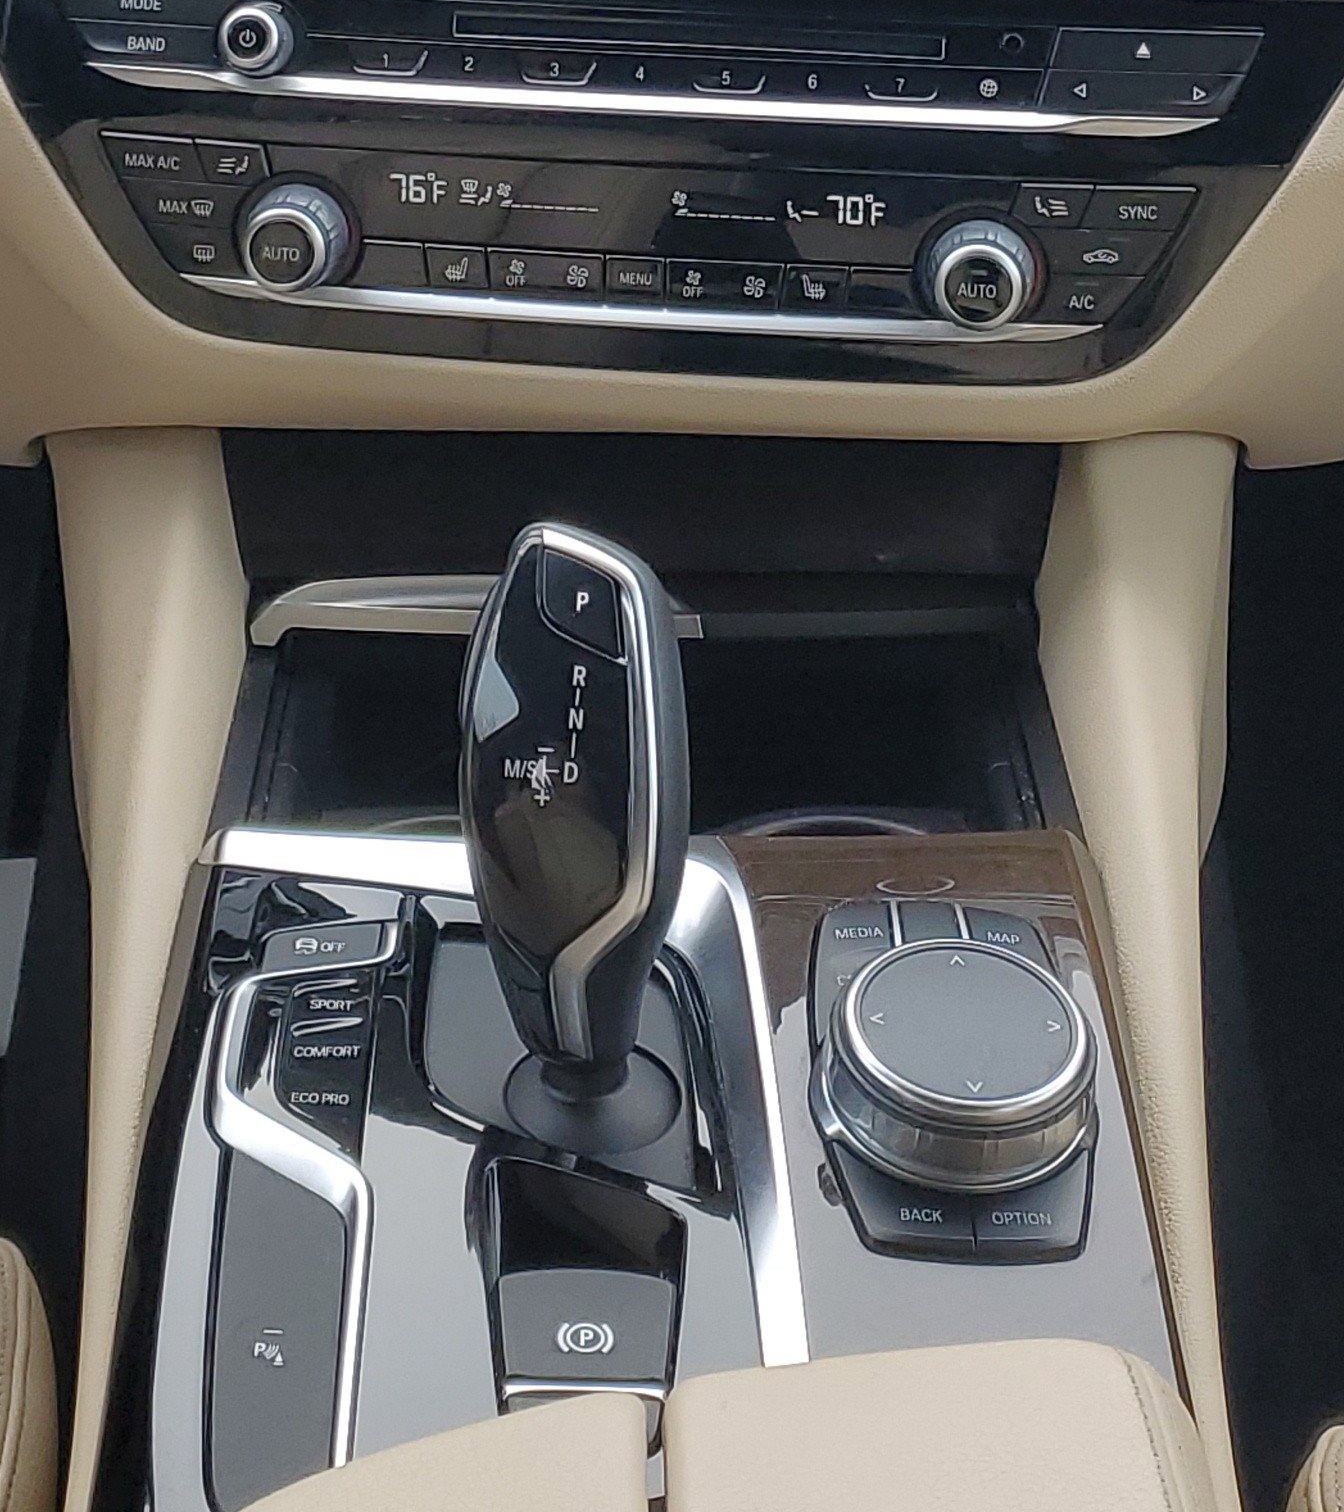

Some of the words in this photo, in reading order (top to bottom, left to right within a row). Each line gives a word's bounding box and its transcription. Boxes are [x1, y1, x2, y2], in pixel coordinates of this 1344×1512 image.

[126, 35, 167, 53] BAND
[382, 52, 390, 69] 1
[463, 56, 475, 72] 2
[549, 62, 560, 78] 3
[634, 65, 645, 81] 4
[721, 70, 731, 86] 5
[808, 74, 818, 90] 6
[896, 77, 906, 93] 7
[124, 154, 154, 169] MAX
[156, 155, 181, 171] A/C
[158, 199, 188, 215] MAX
[1118, 205, 1158, 222] SYNC
[261, 246, 301, 263] AUTO
[505, 273, 526, 286] OFF
[619, 271, 653, 287] MENU
[682, 285, 704, 299] OFF
[957, 283, 998, 300] AUTO
[1068, 294, 1095, 312] A/C
[575, 591, 590, 612] P
[572, 664, 587, 687] R
[568, 708, 584, 730] N
[563, 761, 579, 784] D
[834, 925, 885, 940] MEDIA
[987, 930, 1021, 946] MAP
[320, 941, 346, 953] OFF
[309, 999, 353, 1012] SPORT
[293, 1045, 361, 1059] COMFORT
[290, 1091, 320, 1104] ECO
[321, 1092, 350, 1106] PRO
[900, 1206, 944, 1224] BACK
[991, 1211, 1052, 1227] OPTION
